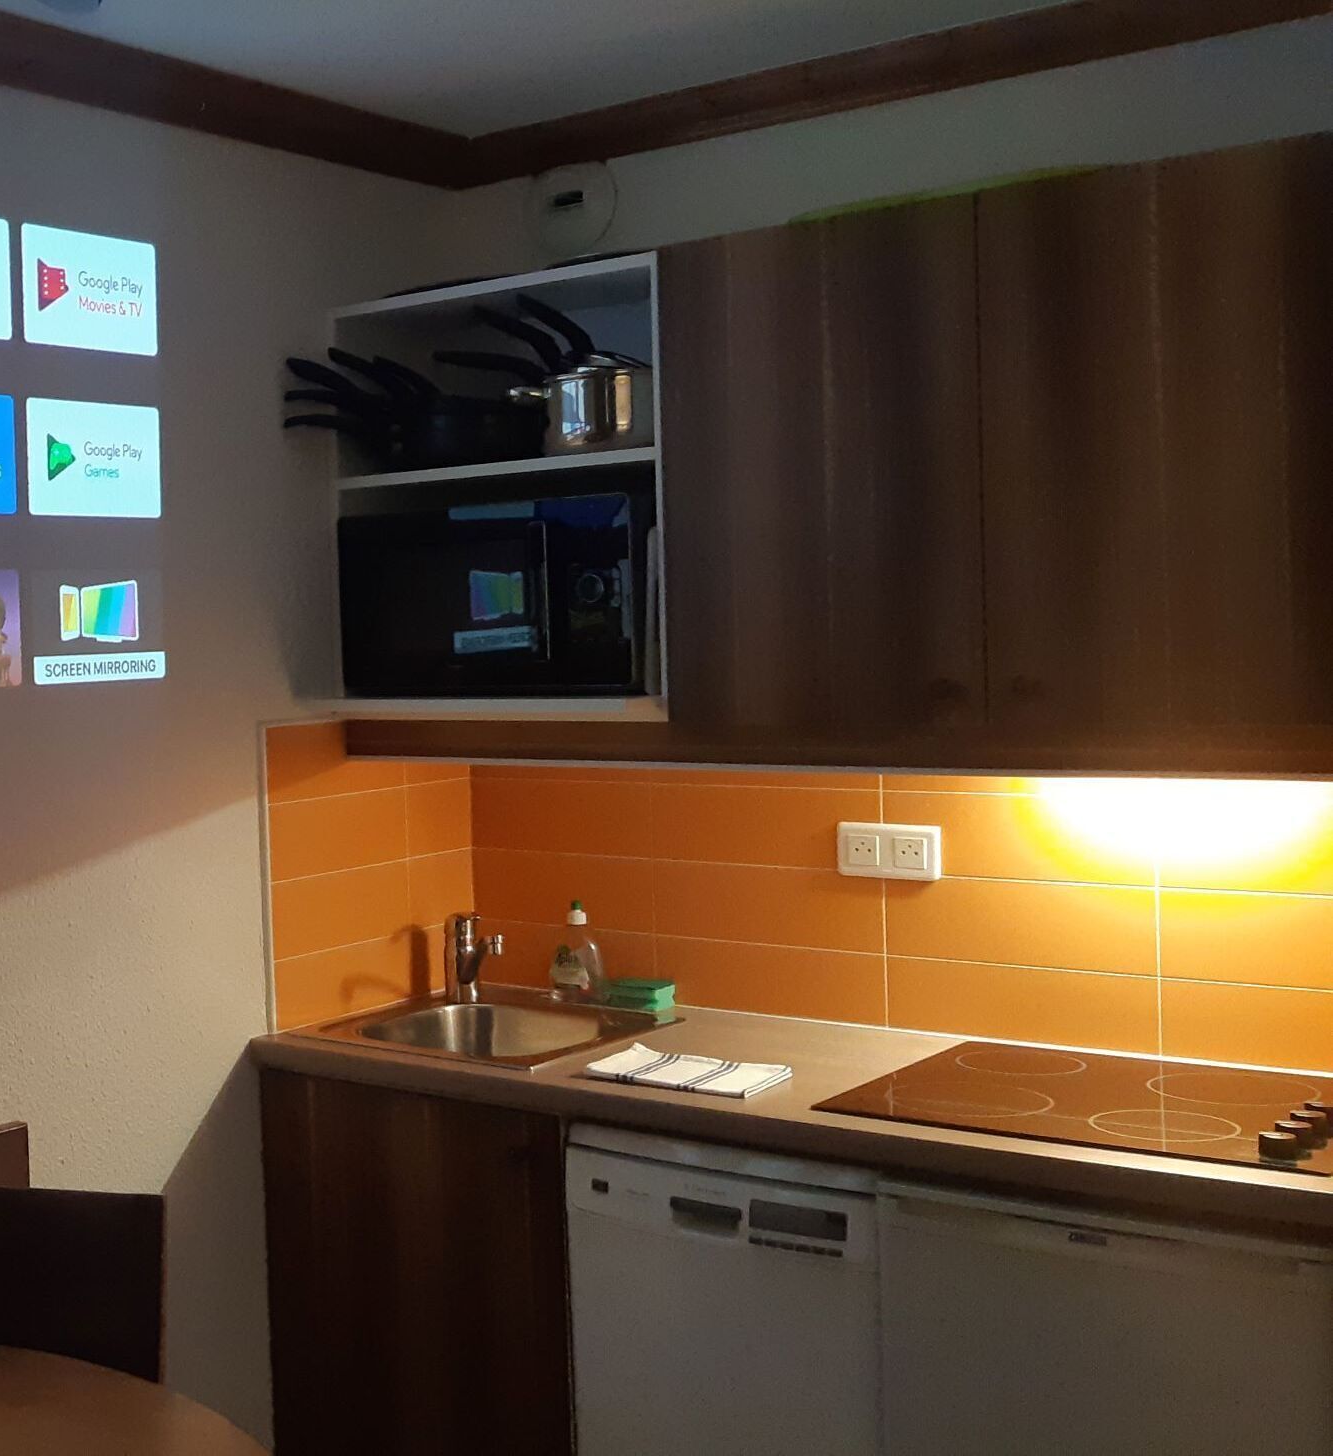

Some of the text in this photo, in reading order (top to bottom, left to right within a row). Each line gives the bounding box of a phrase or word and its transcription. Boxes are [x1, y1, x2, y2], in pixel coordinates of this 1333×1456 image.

[78, 271, 142, 298] Google Play
[79, 296, 142, 317] Movies & TV
[84, 441, 143, 463] Google Play
[84, 464, 119, 478] Games
[45, 659, 156, 677] SCREEN MIRRORING
